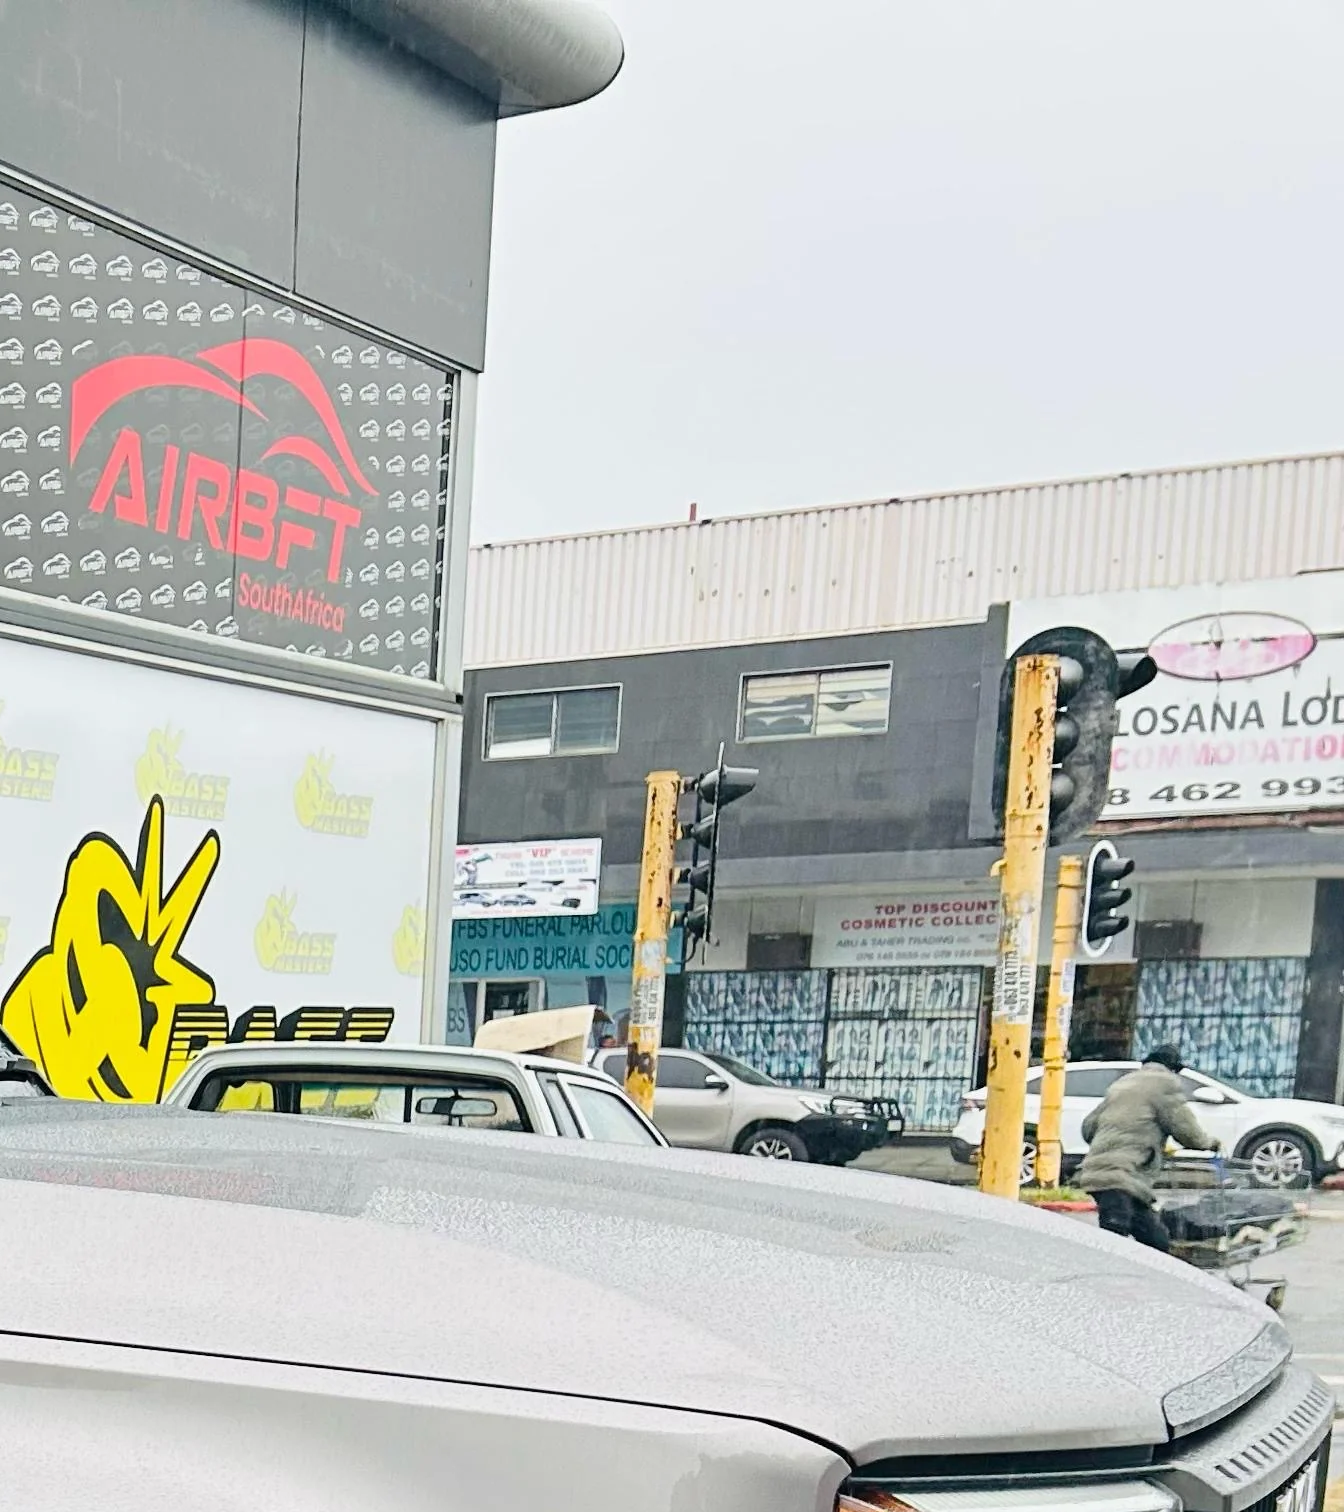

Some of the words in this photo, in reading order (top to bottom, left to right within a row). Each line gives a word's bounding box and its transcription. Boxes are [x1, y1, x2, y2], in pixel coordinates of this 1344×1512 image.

[88, 426, 362, 584] AIRBFT
[1113, 698, 1264, 737] LOSANA
[168, 773, 230, 801] BASS
[1149, 781, 1241, 802] 462
[164, 797, 226, 821] ASTERS
[875, 904, 906, 915] TOP
[912, 900, 999, 914] DISCOUNT
[493, 918, 565, 938] FUNERAL
[841, 917, 925, 930] COSMETIC
[931, 914, 997, 927] COLLEC
[485, 948, 529, 971] FUND
[532, 946, 591, 970] BURIAL
